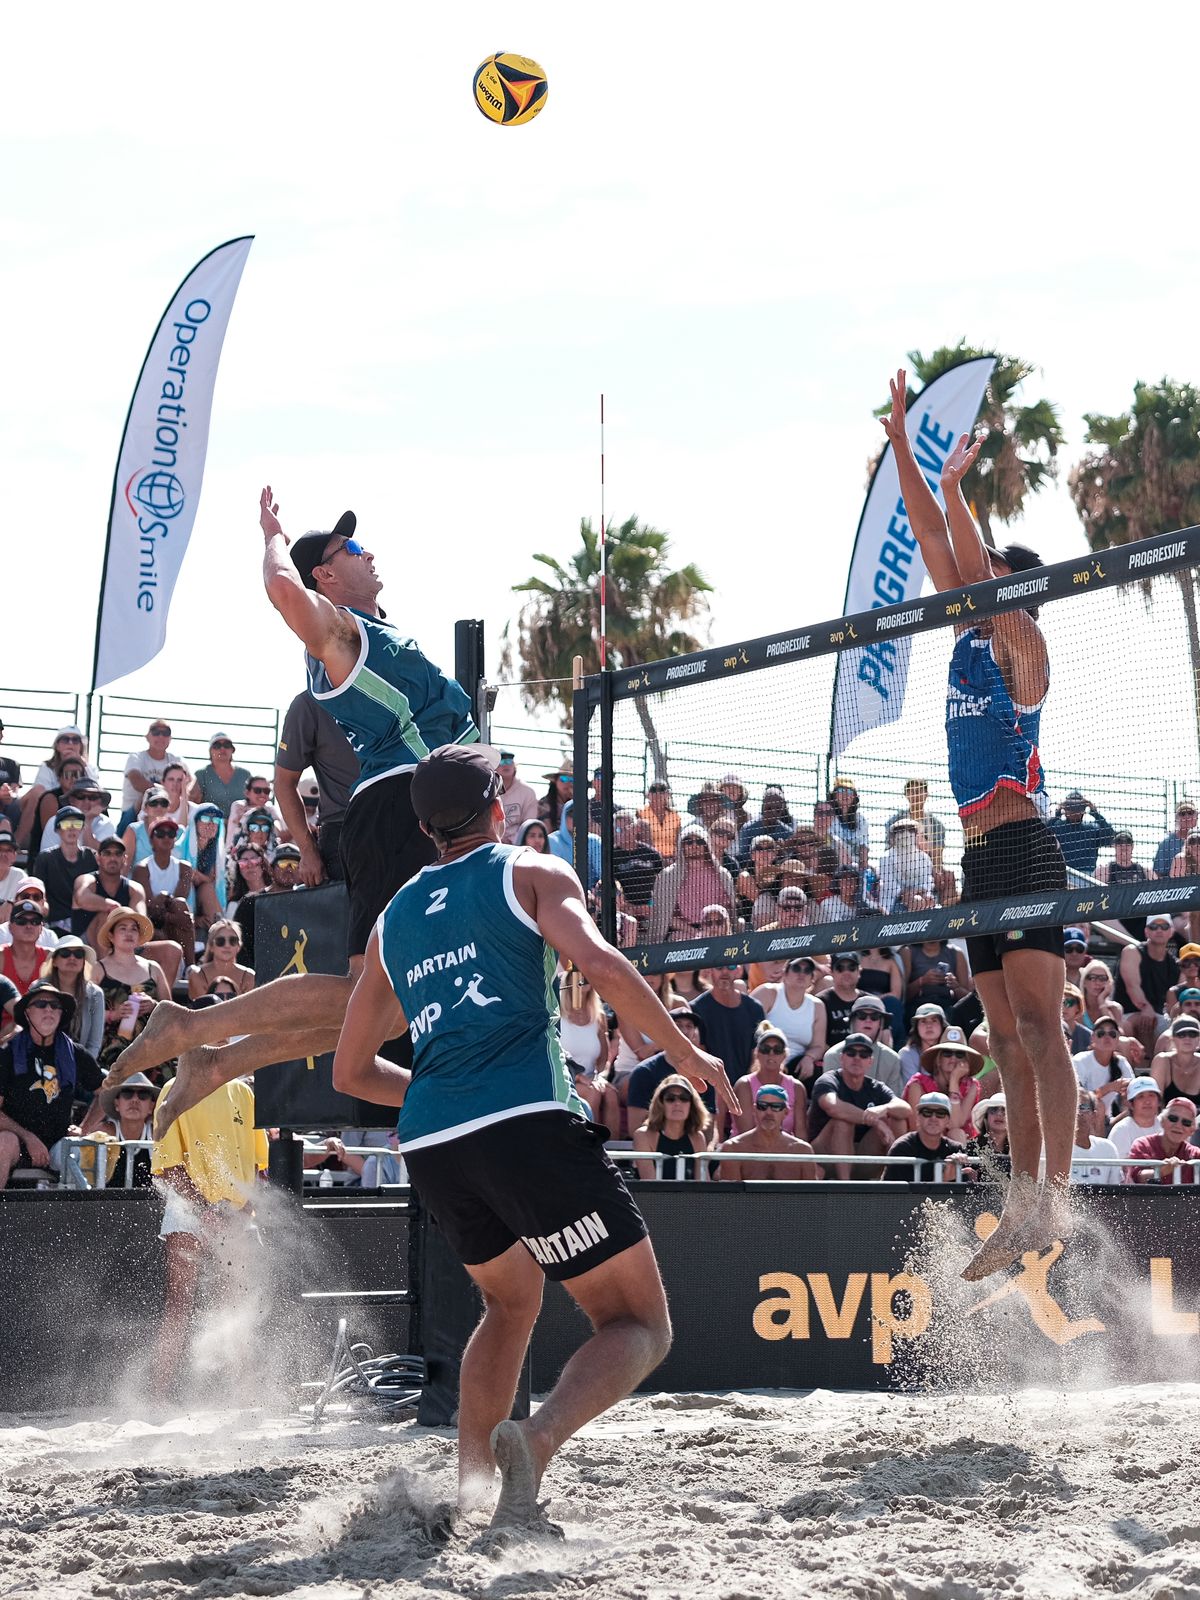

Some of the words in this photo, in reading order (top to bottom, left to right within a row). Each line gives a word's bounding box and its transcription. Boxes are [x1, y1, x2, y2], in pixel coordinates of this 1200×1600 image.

[478, 80, 503, 111] Wilson
[151, 298, 212, 468] Operation
[136, 515, 169, 613] Smile
[627, 674, 640, 691] avp
[665, 660, 708, 681] PROGRESSIVE
[723, 653, 737, 669] avp
[766, 635, 811, 658] PROGRESSIVE
[829, 629, 844, 645] avp
[875, 607, 925, 632] PROGRESSIVE
[945, 602, 962, 617] avp
[996, 576, 1049, 603] PROGRESSIVE
[1072, 569, 1090, 585] avp
[1128, 540, 1187, 570] PROGRESSIVE
[424, 887, 449, 916] 2
[664, 946, 709, 964] PROGRESSIVE
[723, 945, 739, 958] avp
[767, 934, 816, 952] PROGRESSIVE
[831, 932, 847, 946] avp
[877, 919, 932, 938] PROGRESSIVE
[947, 916, 965, 931] avp
[999, 901, 1058, 921] PROGRESSIVE
[1076, 901, 1094, 914] avp
[1132, 885, 1198, 906] PROGRESSIVE
[406, 941, 477, 988] PARTAIN
[409, 1001, 442, 1044] avp
[752, 1270, 933, 1365] avp
